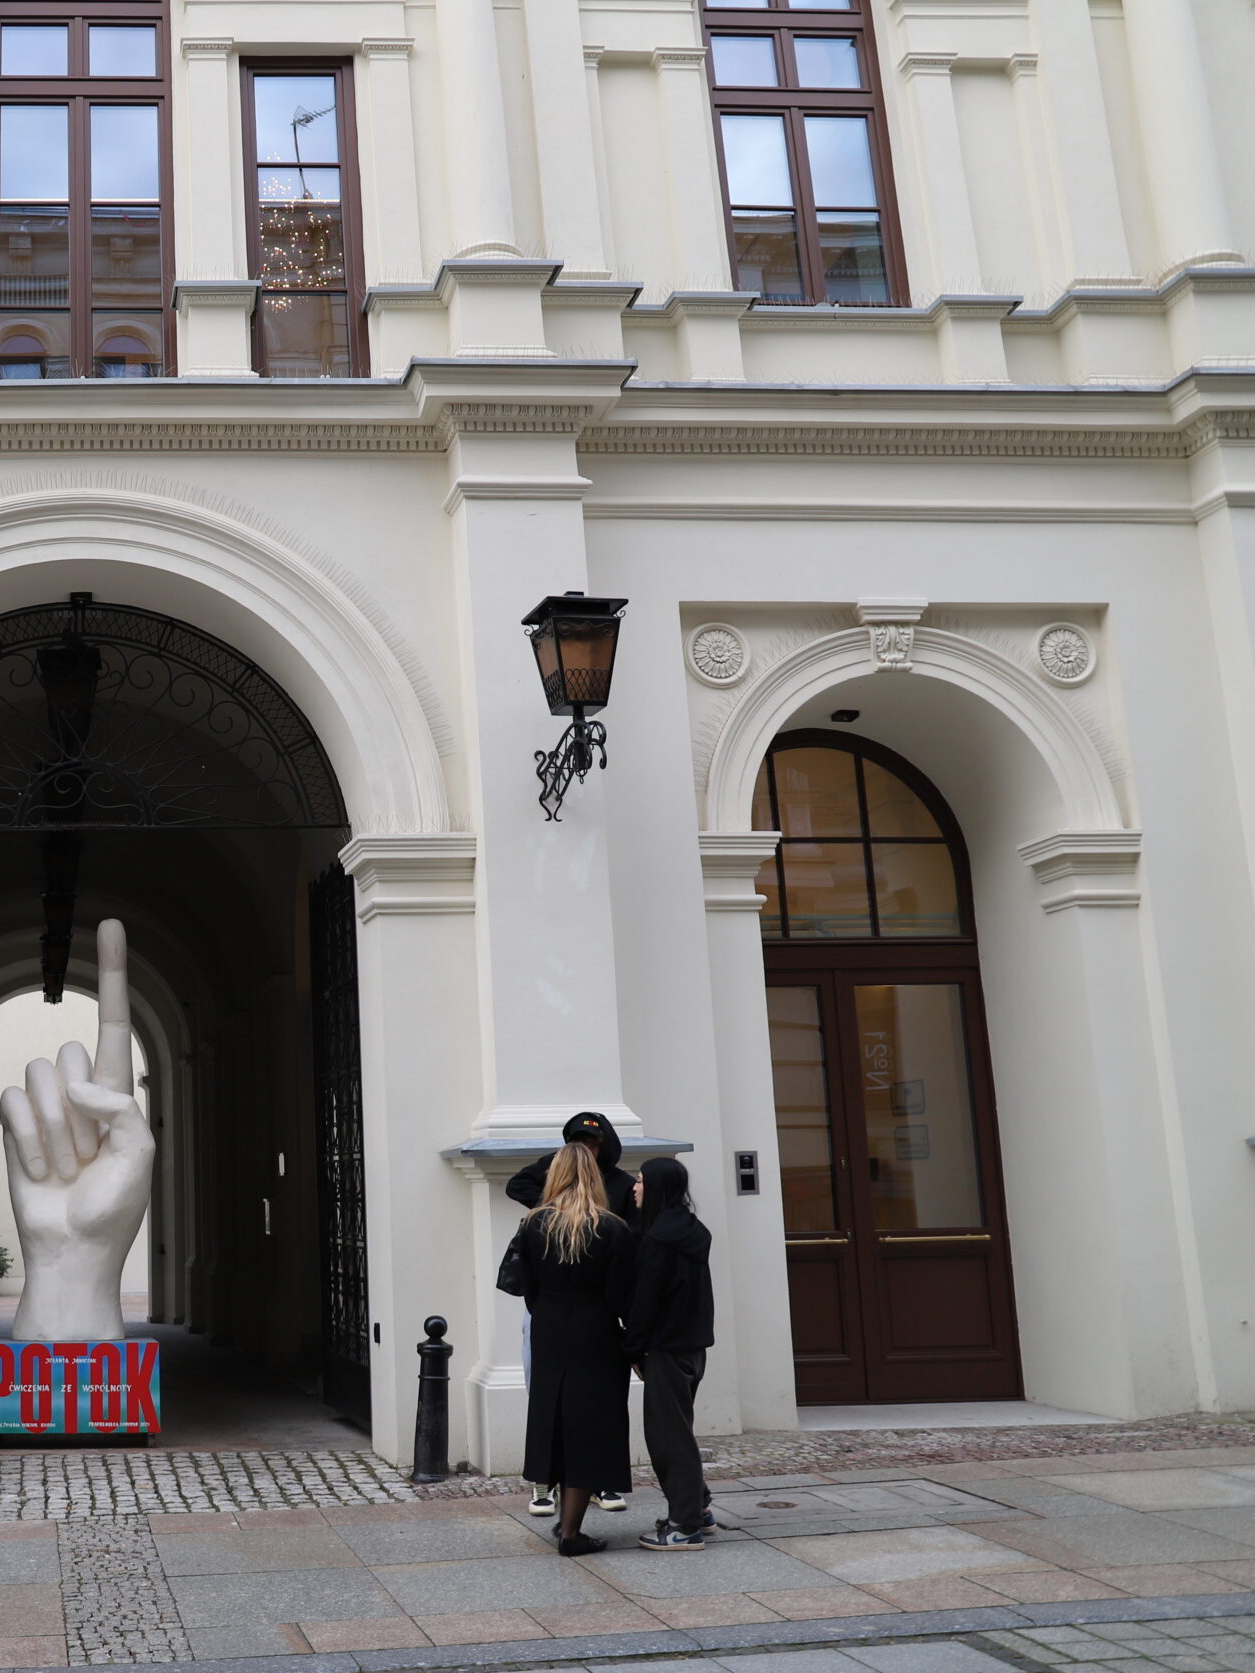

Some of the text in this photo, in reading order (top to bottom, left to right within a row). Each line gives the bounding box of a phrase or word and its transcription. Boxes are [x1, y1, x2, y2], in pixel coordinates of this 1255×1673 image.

[8, 1381, 132, 1393] ĆWICZENIA ZE WSPÓLNOTY
